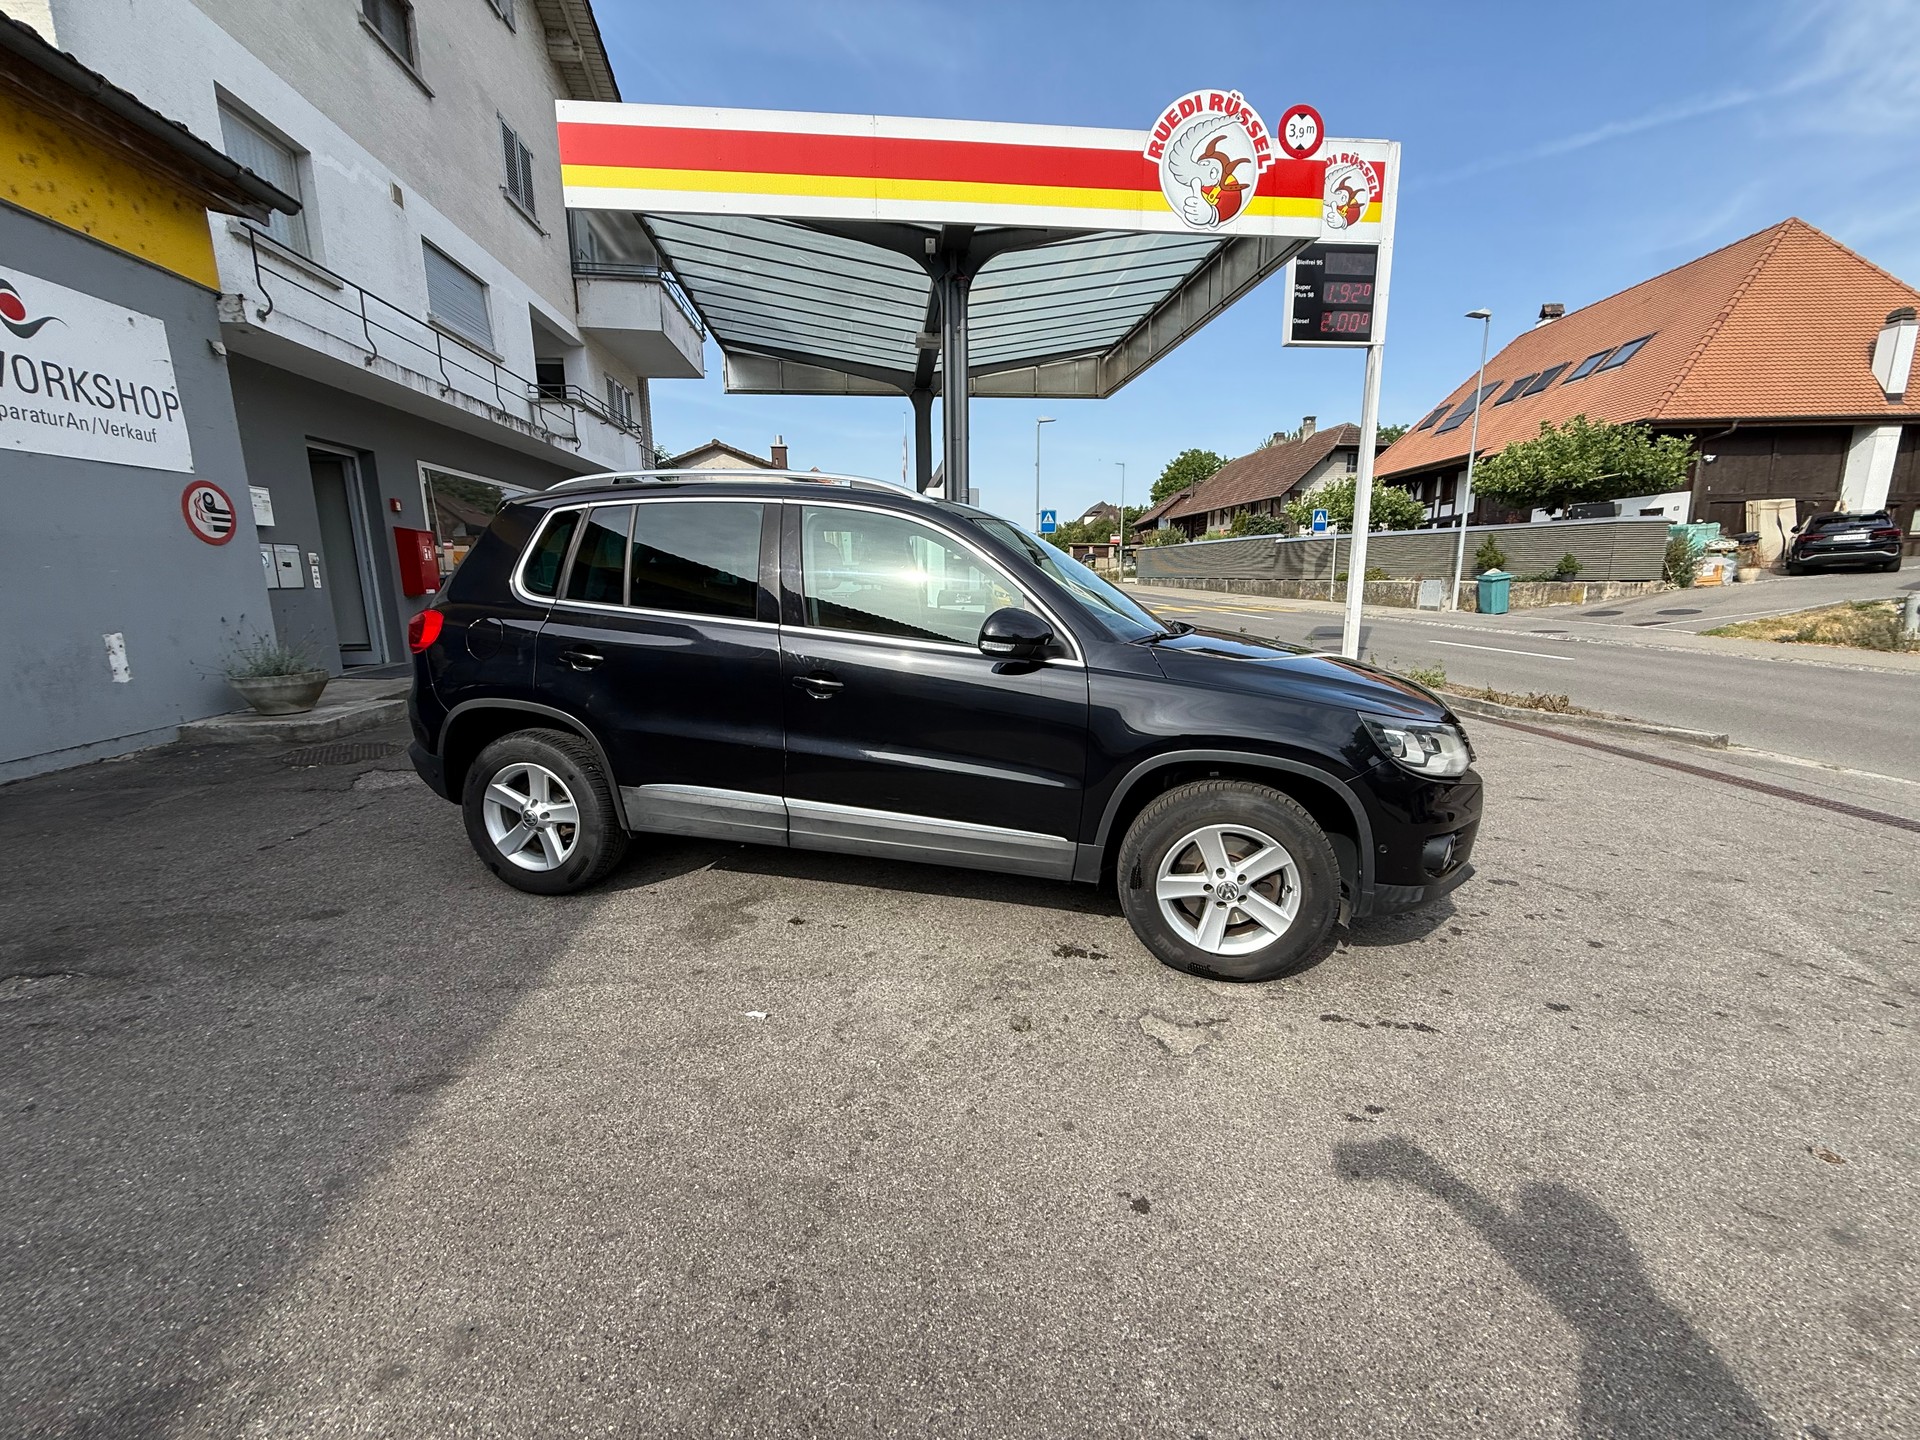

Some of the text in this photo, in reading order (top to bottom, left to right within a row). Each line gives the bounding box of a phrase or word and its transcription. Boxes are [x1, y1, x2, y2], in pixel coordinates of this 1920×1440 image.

[1147, 93, 1272, 169] RUEDI RÜSSEL
[1340, 152, 1377, 195] RÜSSEL
